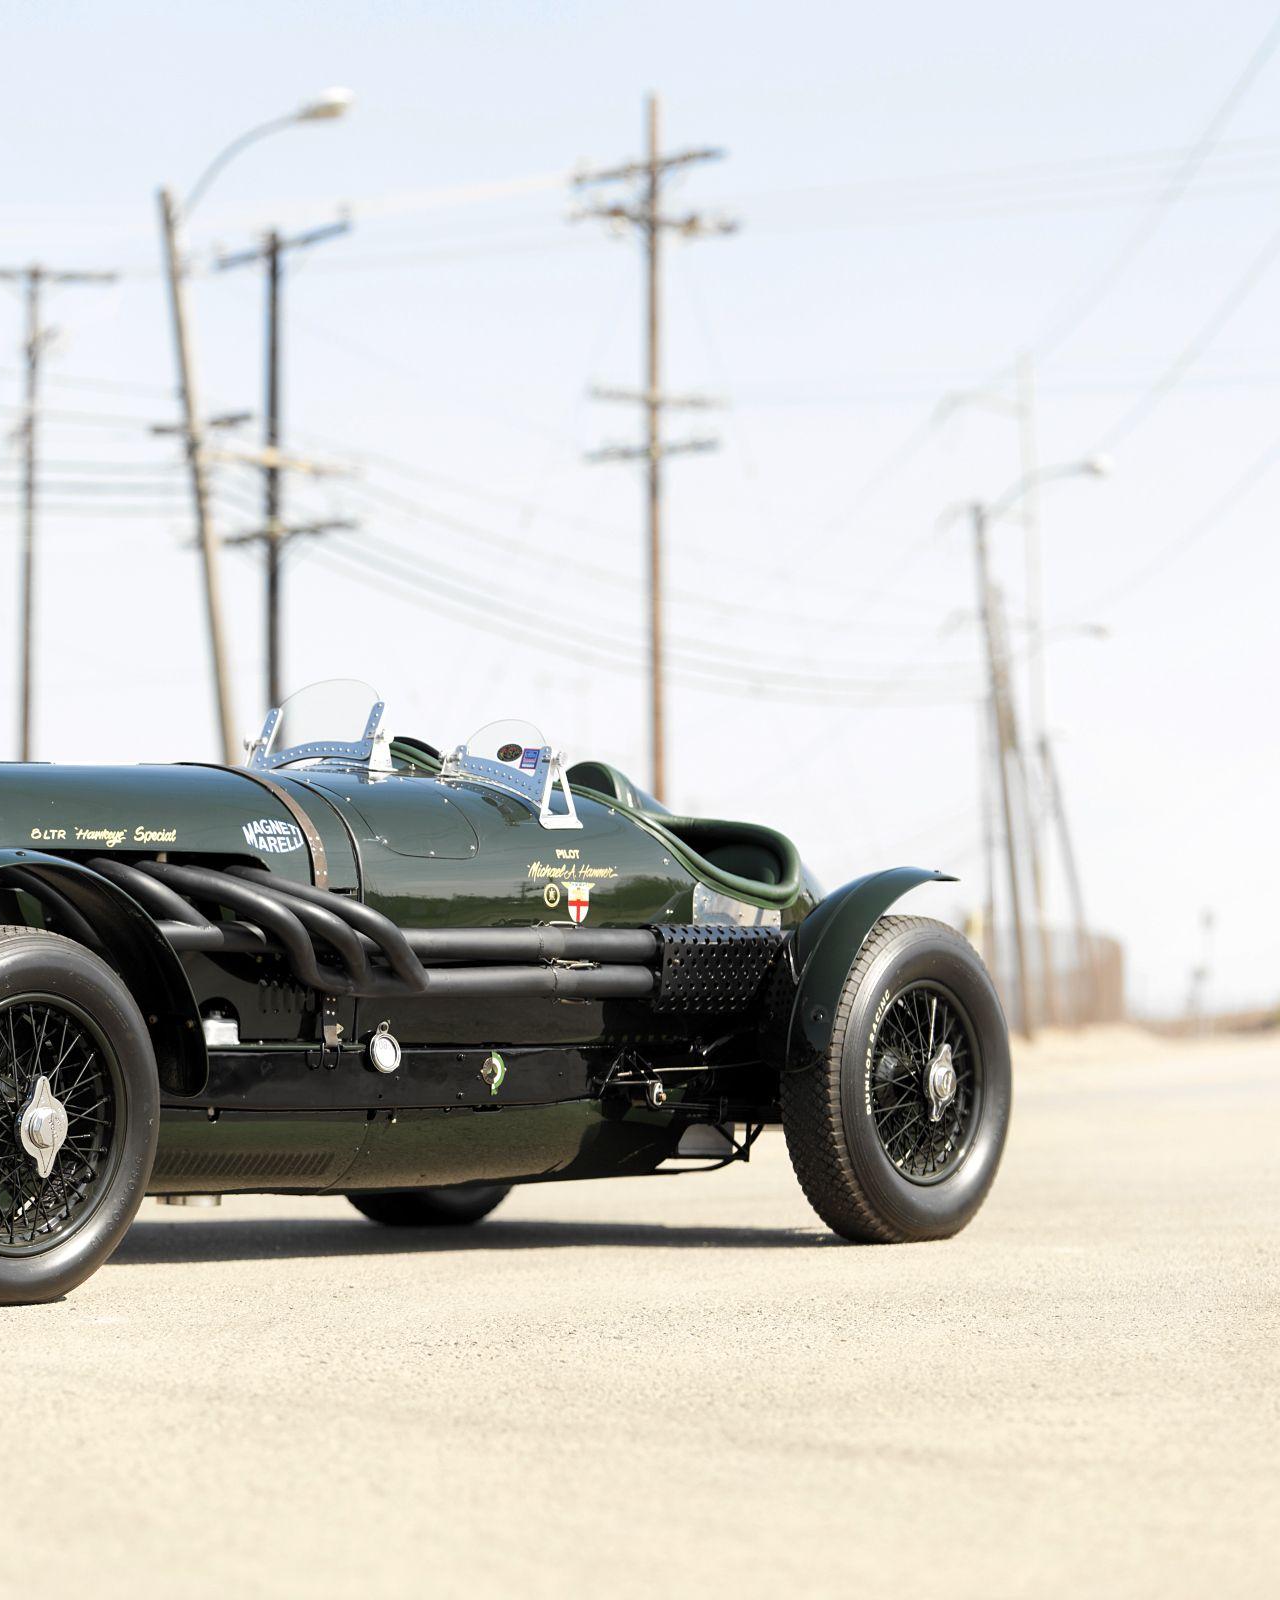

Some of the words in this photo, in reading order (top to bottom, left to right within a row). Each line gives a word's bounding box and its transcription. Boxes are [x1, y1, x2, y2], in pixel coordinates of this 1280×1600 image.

[133, 825, 177, 843] Special
[555, 849, 580, 859] PILOT
[864, 1048, 872, 1115] DUNLOP
[869, 989, 890, 1043] RACING
